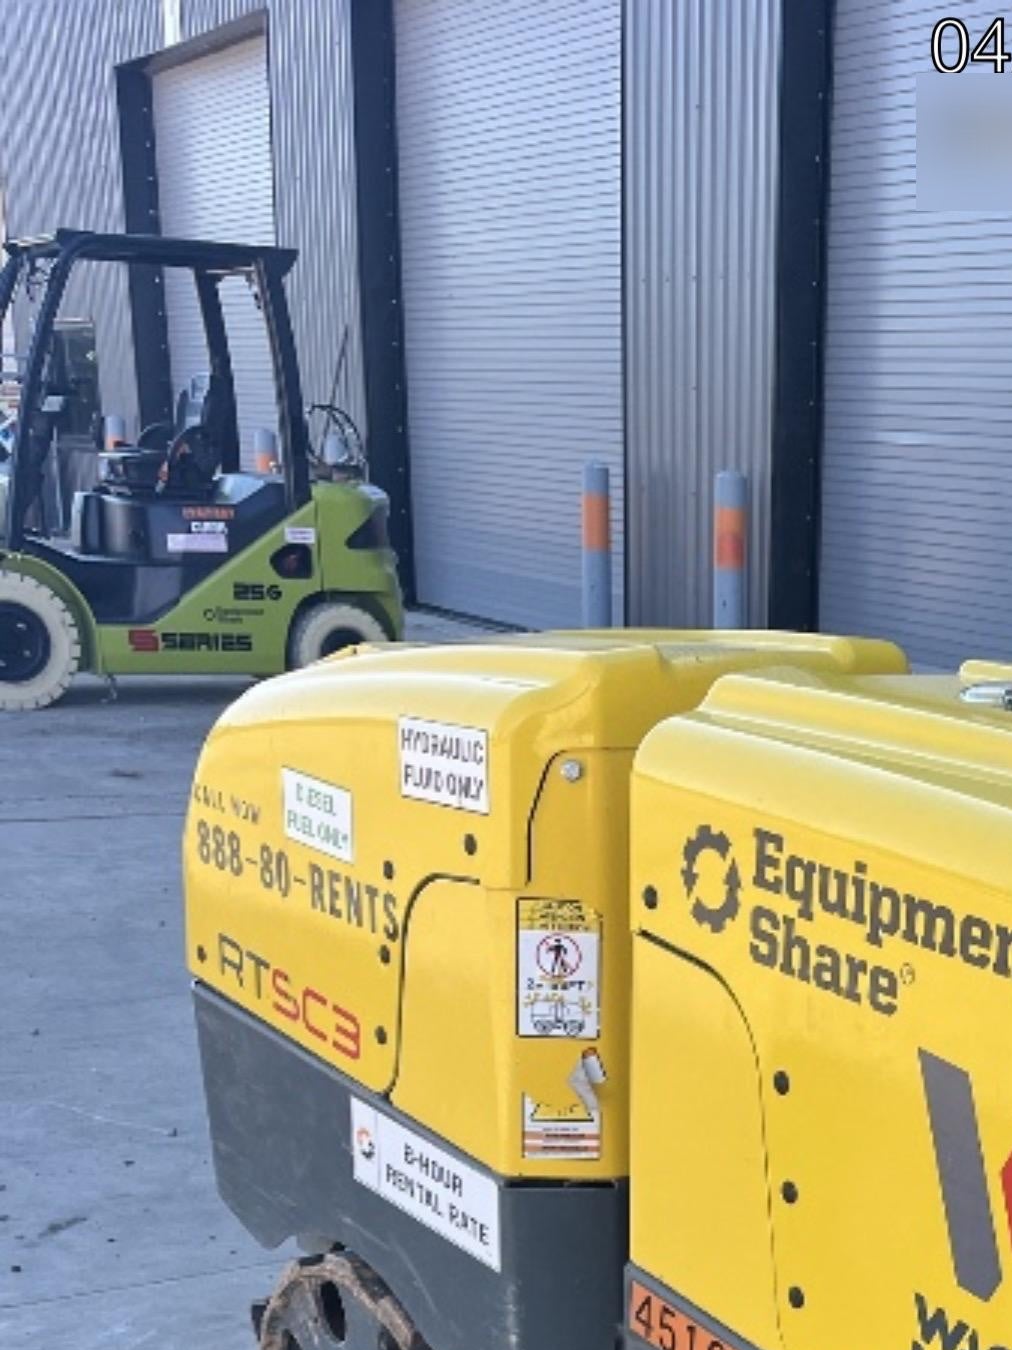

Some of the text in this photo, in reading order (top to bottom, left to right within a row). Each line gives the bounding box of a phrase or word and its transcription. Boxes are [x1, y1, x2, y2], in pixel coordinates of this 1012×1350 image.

[401, 728, 484, 765] HYDRAULIC
[404, 764, 484, 803] FLUID ONLY
[197, 818, 400, 943] 888-80-RENTS
[386, 1163, 490, 1245] RENTAL RATE
